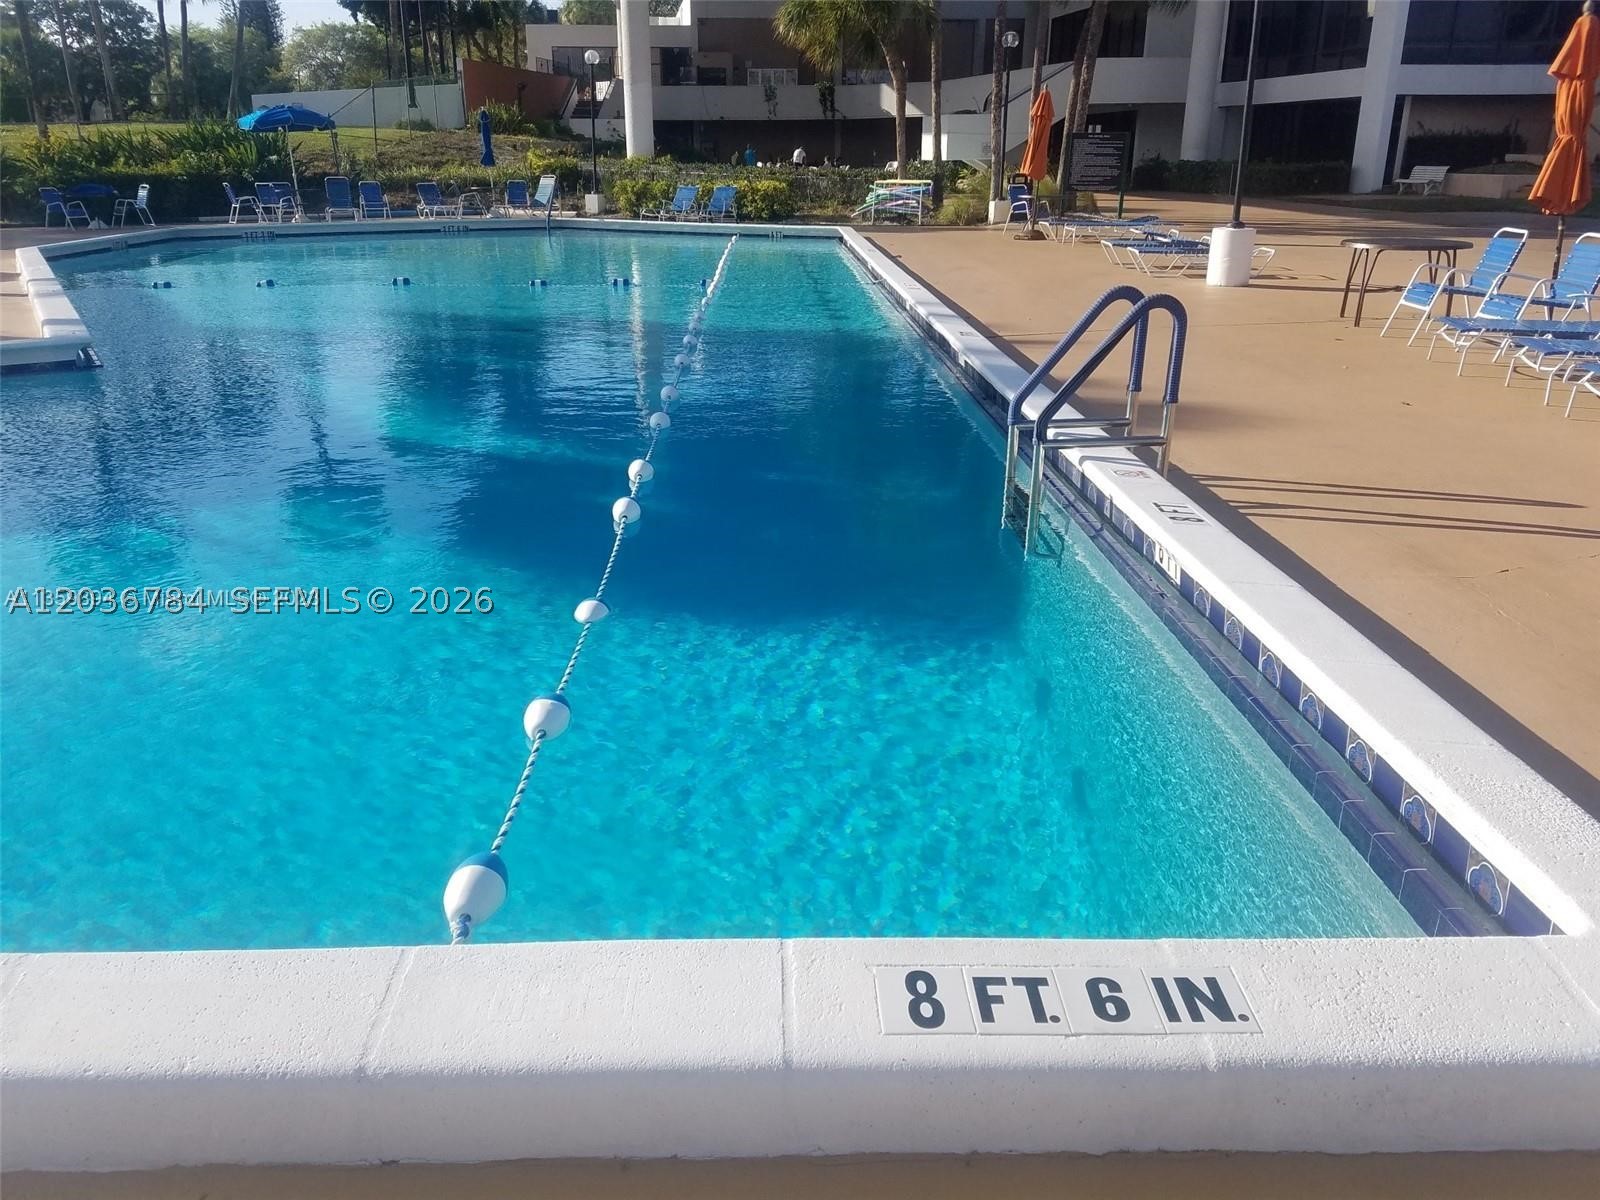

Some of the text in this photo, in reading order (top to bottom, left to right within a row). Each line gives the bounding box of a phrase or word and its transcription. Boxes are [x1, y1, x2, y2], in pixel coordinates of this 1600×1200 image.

[904, 970, 1251, 1029] 8 FT. 6 IN.
